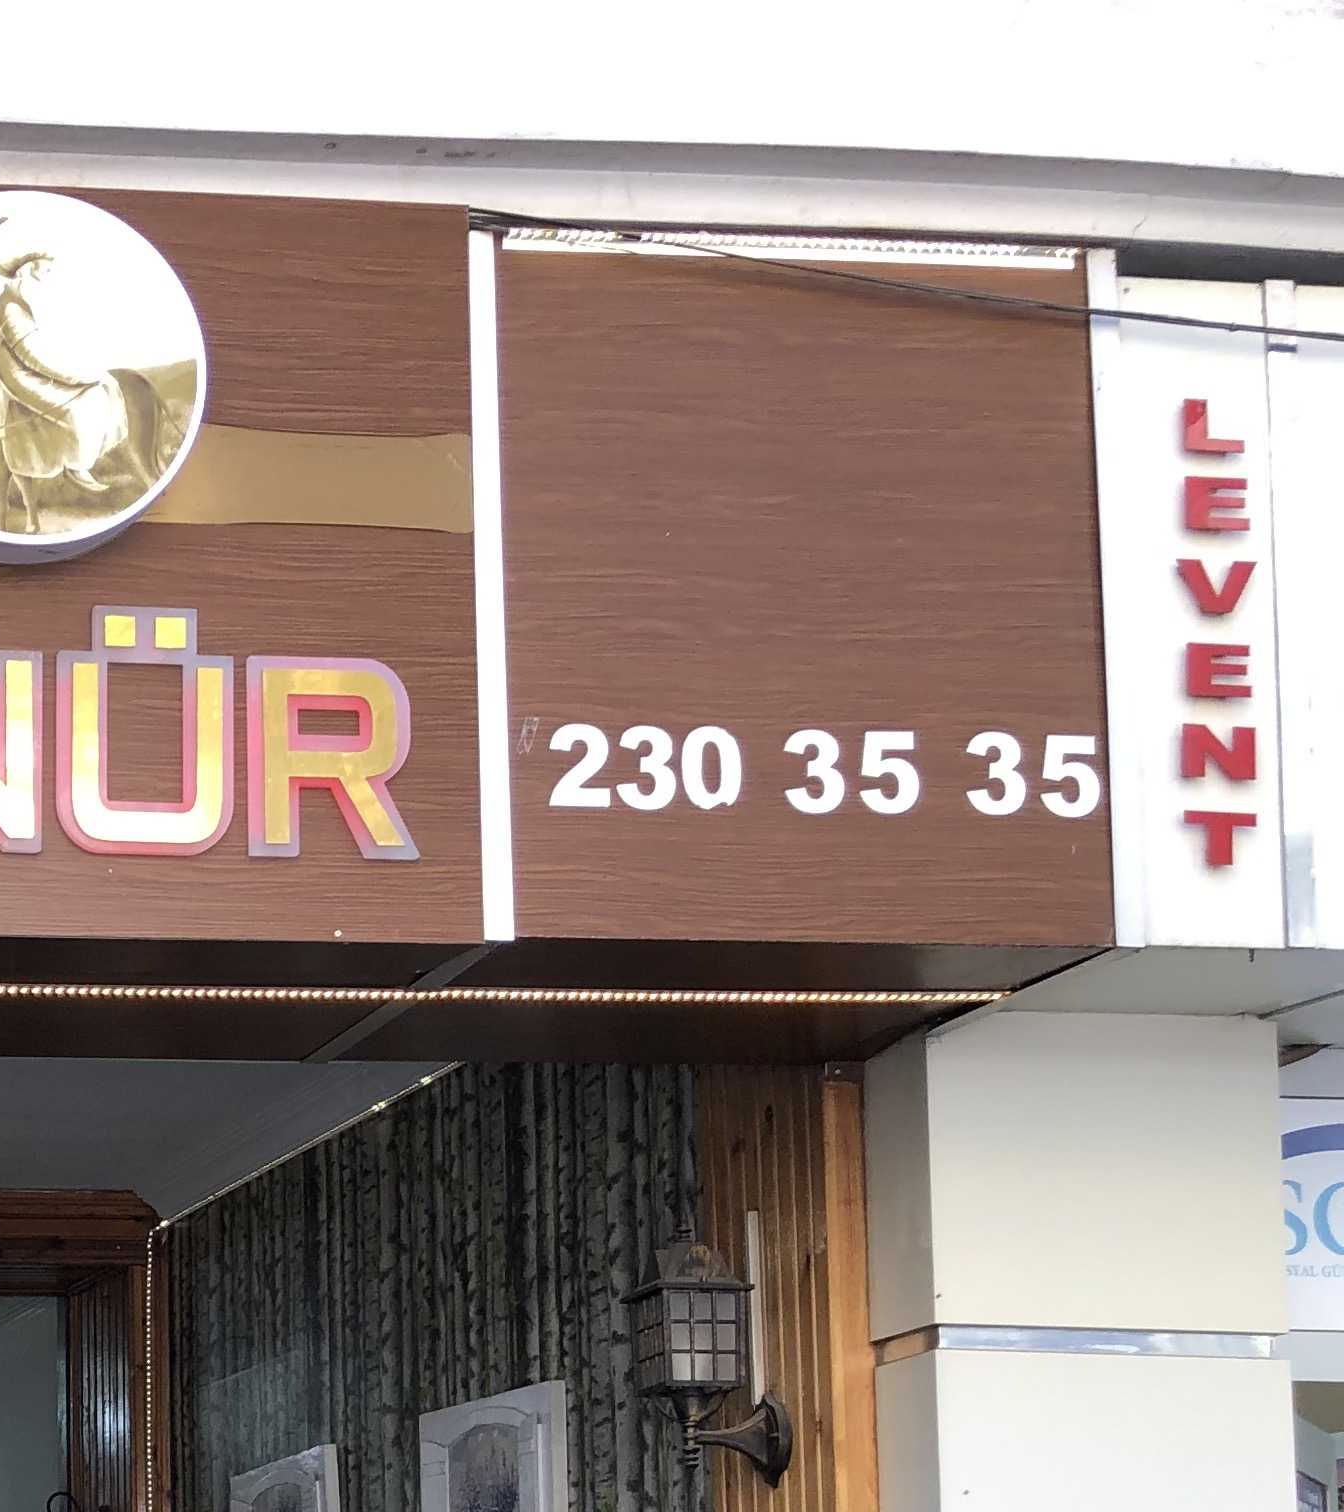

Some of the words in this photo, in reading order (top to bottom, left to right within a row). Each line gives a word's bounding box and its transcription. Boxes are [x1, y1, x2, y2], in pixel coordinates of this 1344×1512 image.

[548, 723, 743, 811] 230
[782, 729, 921, 815] 35
[965, 731, 1101, 818] 35
[1175, 398, 1258, 869] LEVENT
